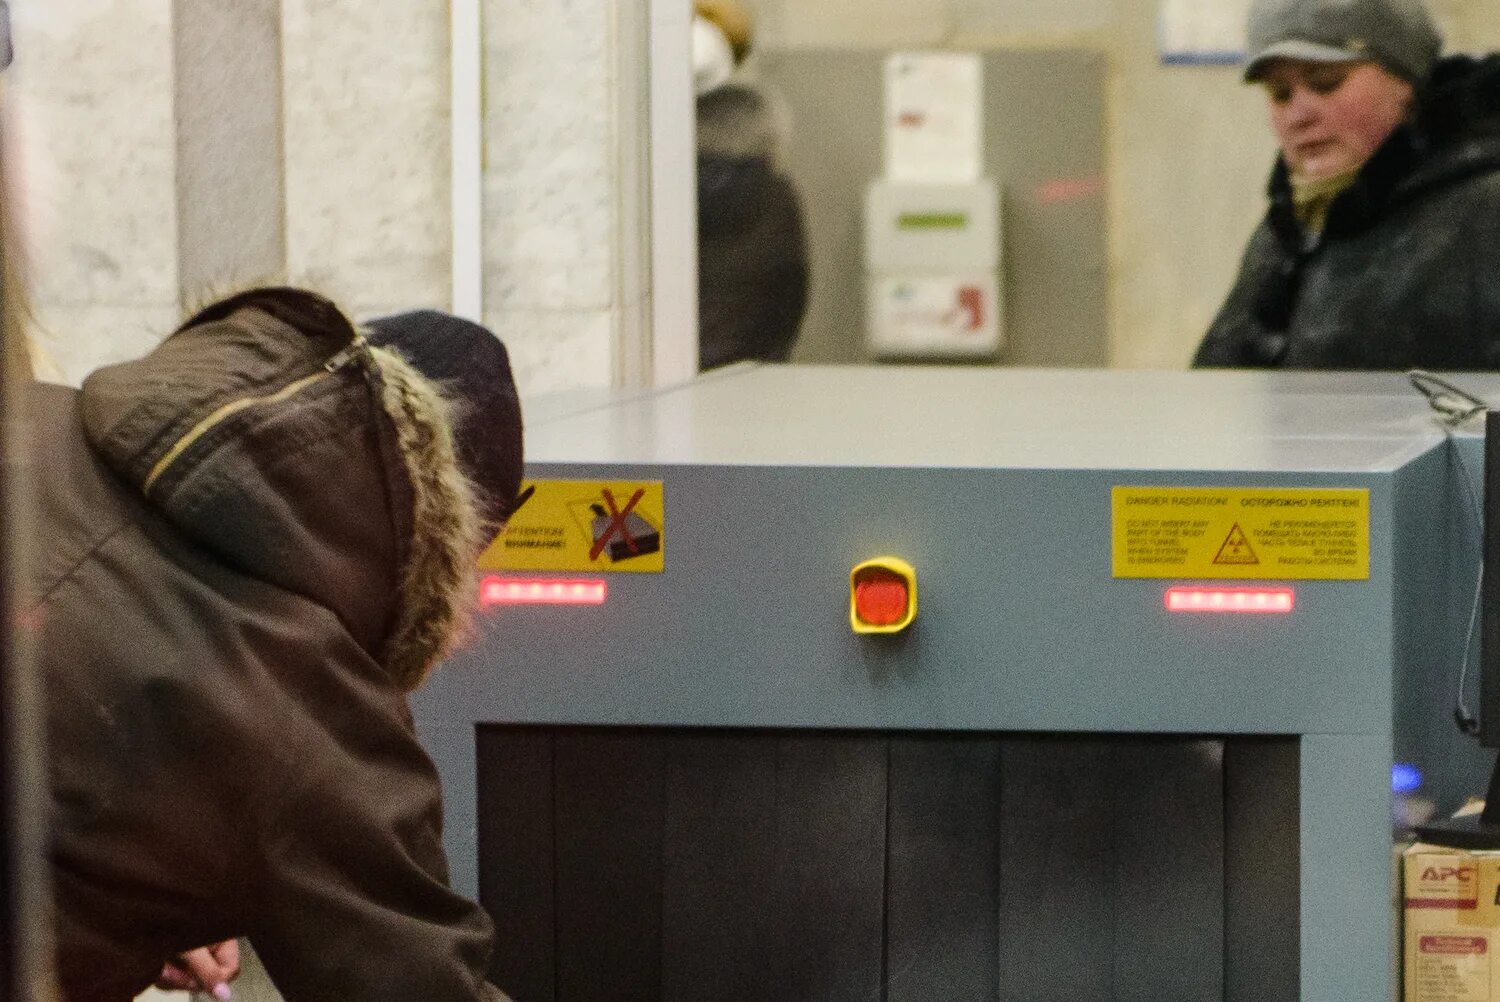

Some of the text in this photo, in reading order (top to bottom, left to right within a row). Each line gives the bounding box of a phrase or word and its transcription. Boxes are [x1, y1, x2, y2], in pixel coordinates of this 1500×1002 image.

[1125, 496, 1168, 506] DANGER
[1240, 498, 1307, 508] ОСТОРОЖНО
[1421, 866, 1475, 882] APC
